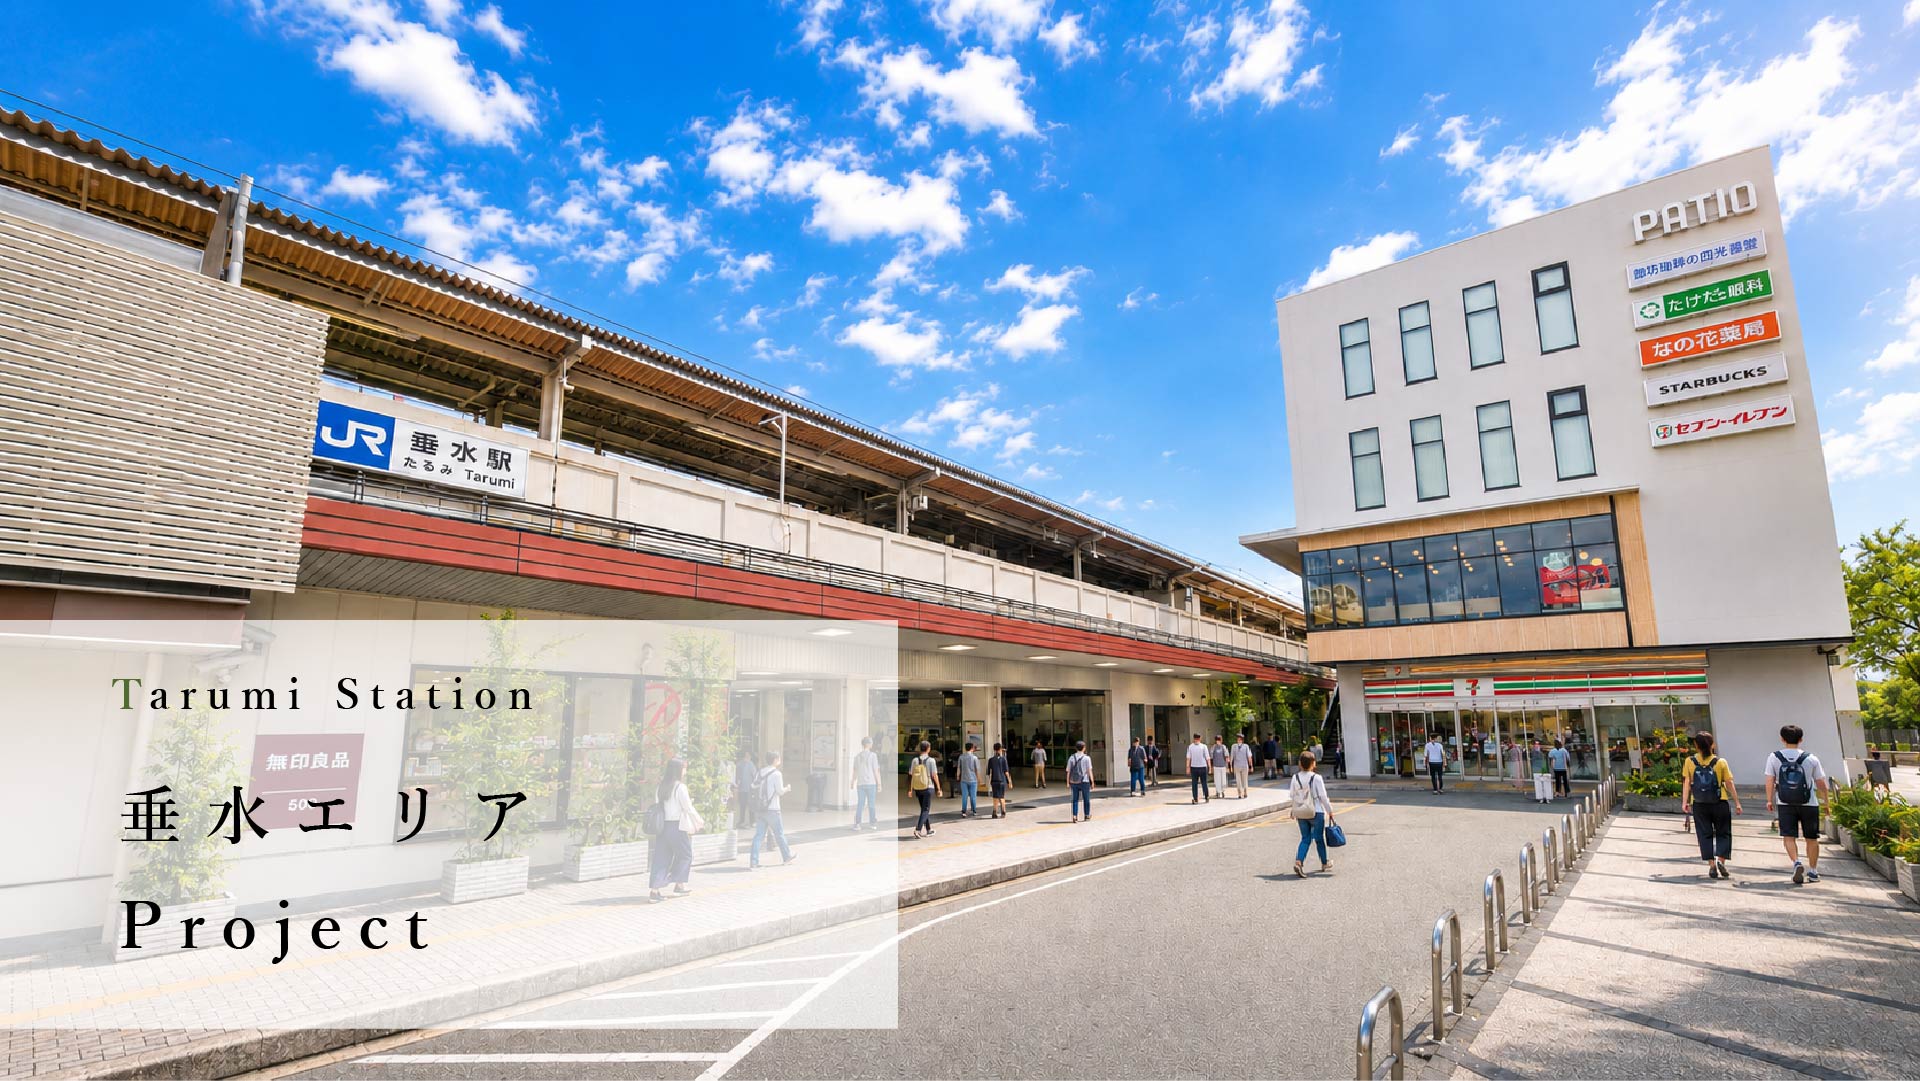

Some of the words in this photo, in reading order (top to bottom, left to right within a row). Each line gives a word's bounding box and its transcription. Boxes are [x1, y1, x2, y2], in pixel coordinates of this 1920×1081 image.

[1632, 180, 1758, 244] PATIO
[1651, 320, 1765, 357] なの花薬局
[1659, 365, 1767, 395] STARBUCKS
[321, 419, 387, 457] JR
[410, 431, 512, 473] 垂水駅
[403, 456, 452, 475] たるみ
[464, 468, 515, 490] Tarumi
[265, 752, 350, 771] 無印良品
